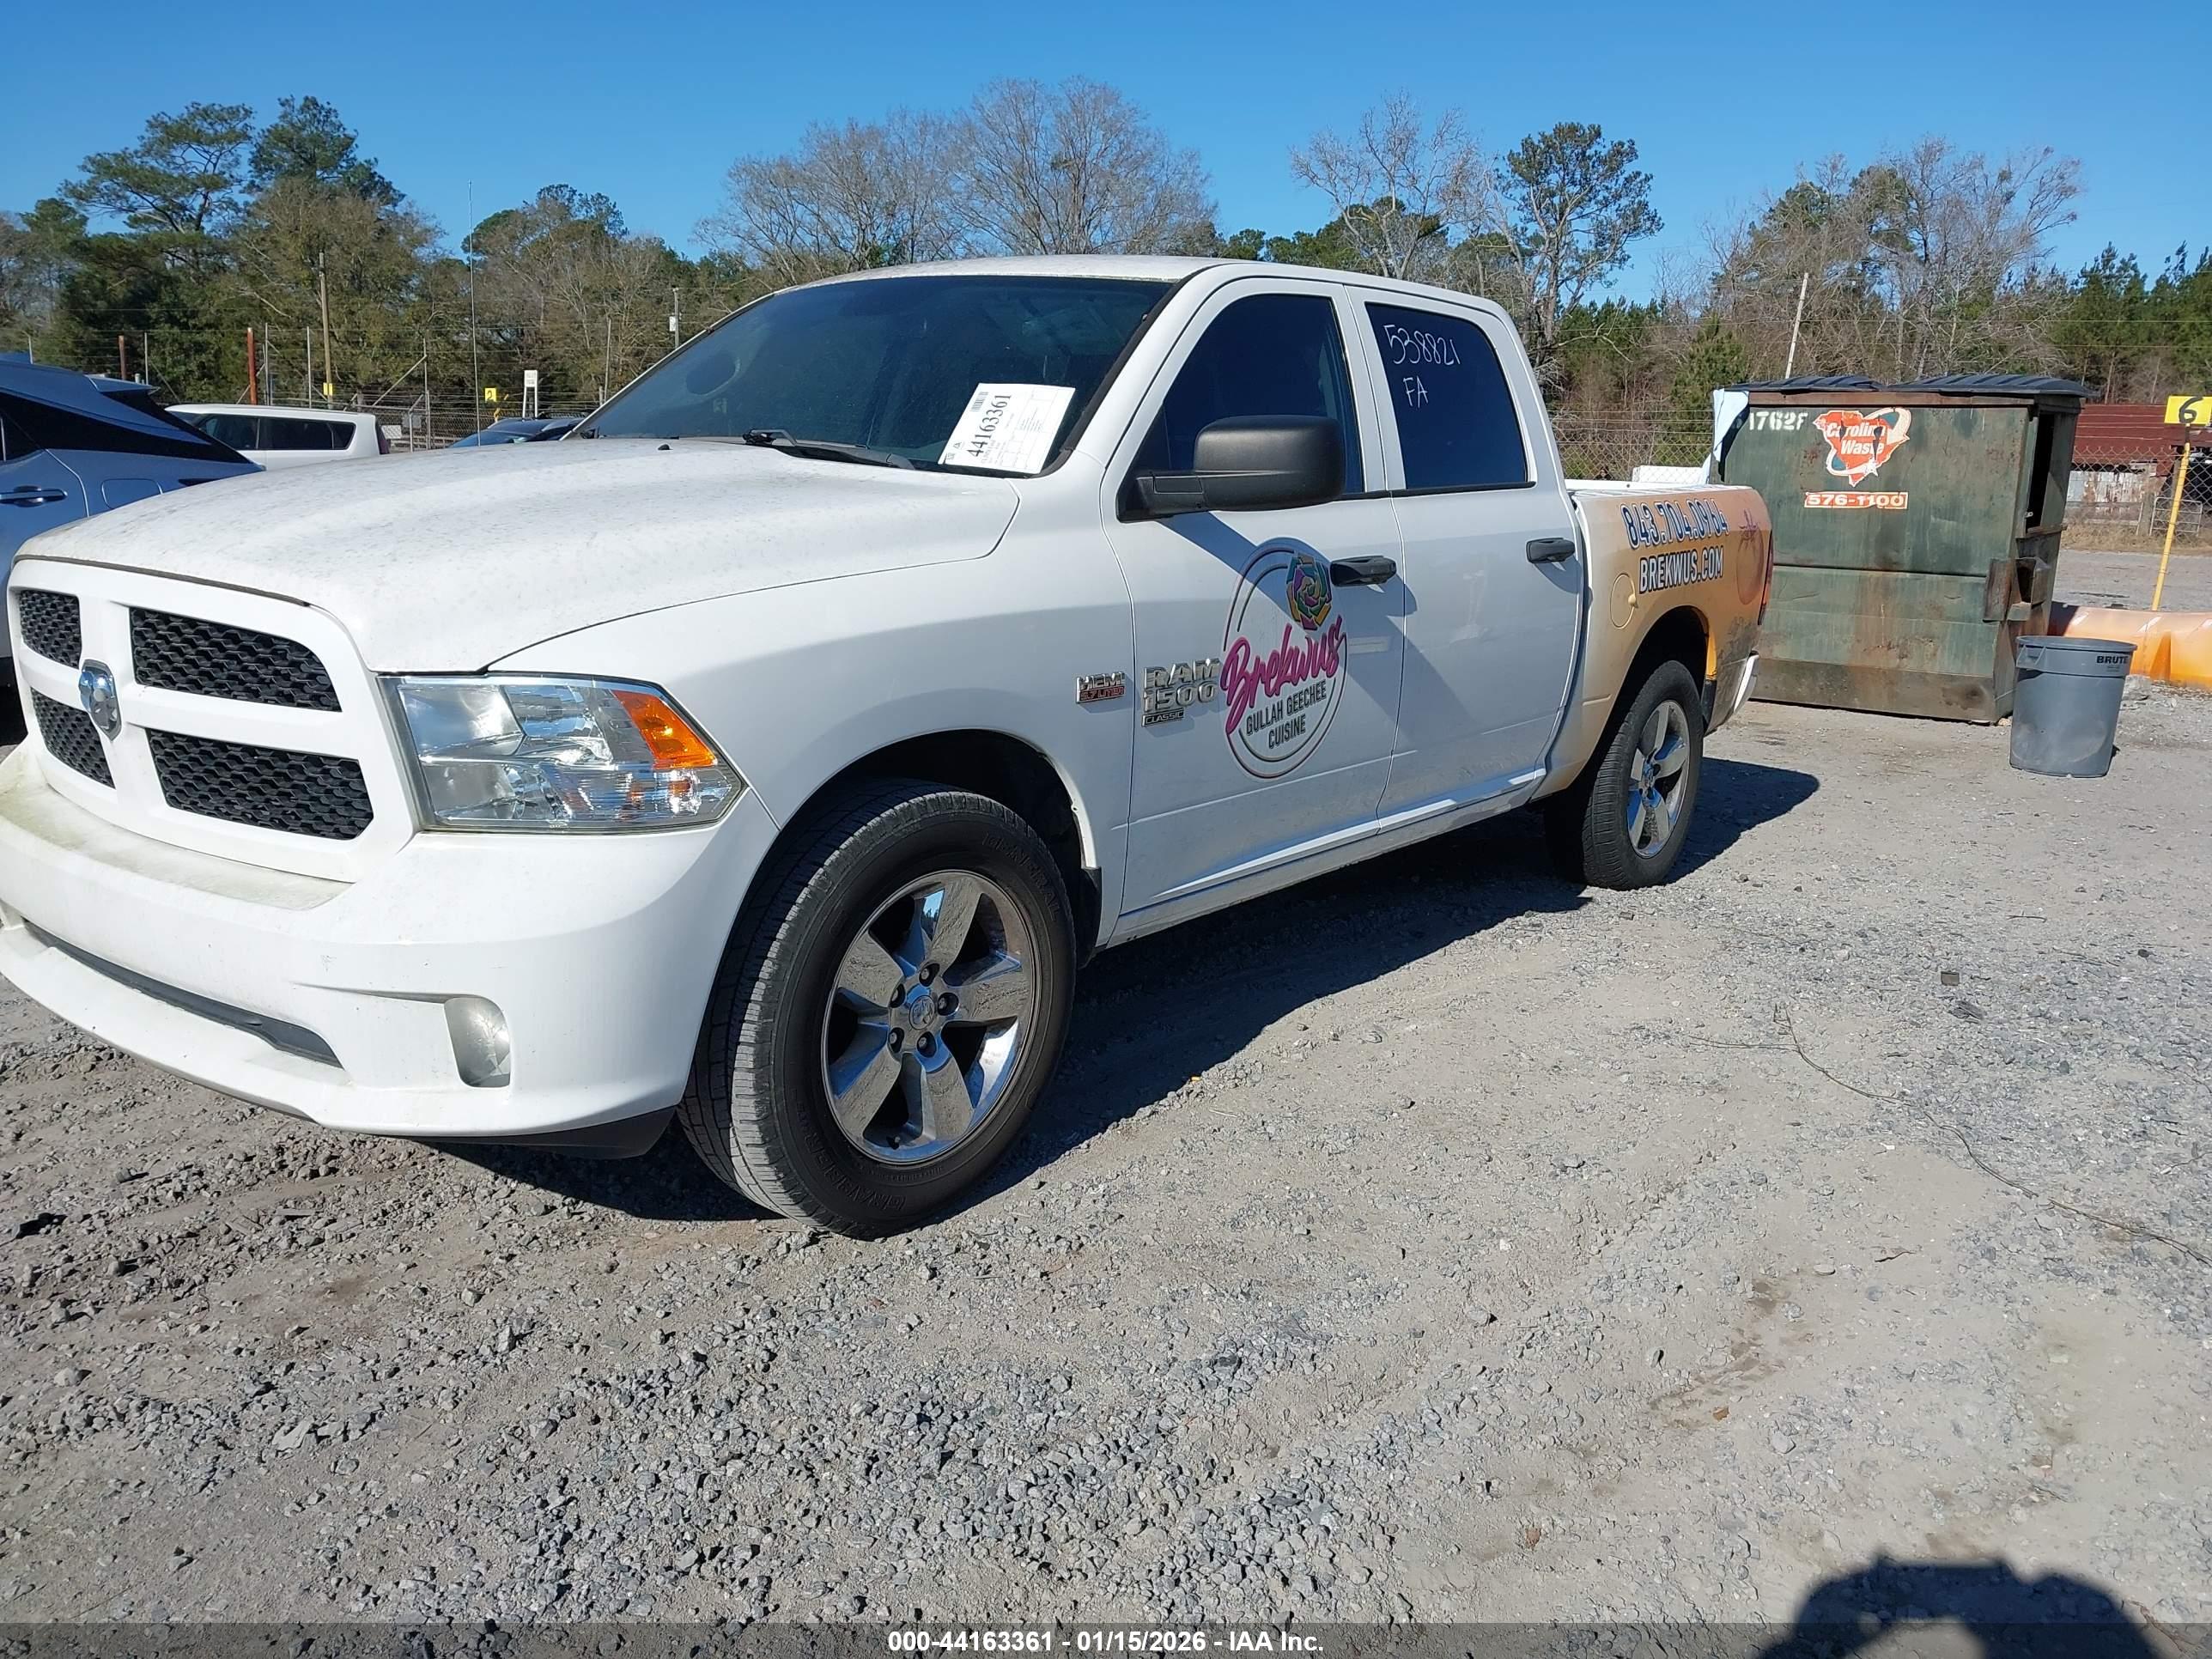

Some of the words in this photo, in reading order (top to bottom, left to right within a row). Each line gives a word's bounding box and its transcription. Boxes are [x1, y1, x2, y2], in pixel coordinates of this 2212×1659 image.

[1382, 324, 1461, 366] 538821
[1403, 375, 1429, 409] FA
[2179, 394, 2204, 424] 6
[966, 395, 1012, 457] 44163361
[1808, 494, 1904, 507] 576-1100
[1639, 545, 1725, 594] BREKWUS.COM
[1076, 672, 1125, 692] HEMI
[1144, 659, 1219, 690] RAM
[1220, 615, 1343, 734] Brekwus
[1143, 681, 1218, 712] 1500
[1246, 699, 1283, 736] GULLAH
[1287, 679, 1327, 717] GEECHEE
[1146, 708, 1184, 725] CLASSIC
[1268, 714, 1306, 749] CUISINE
